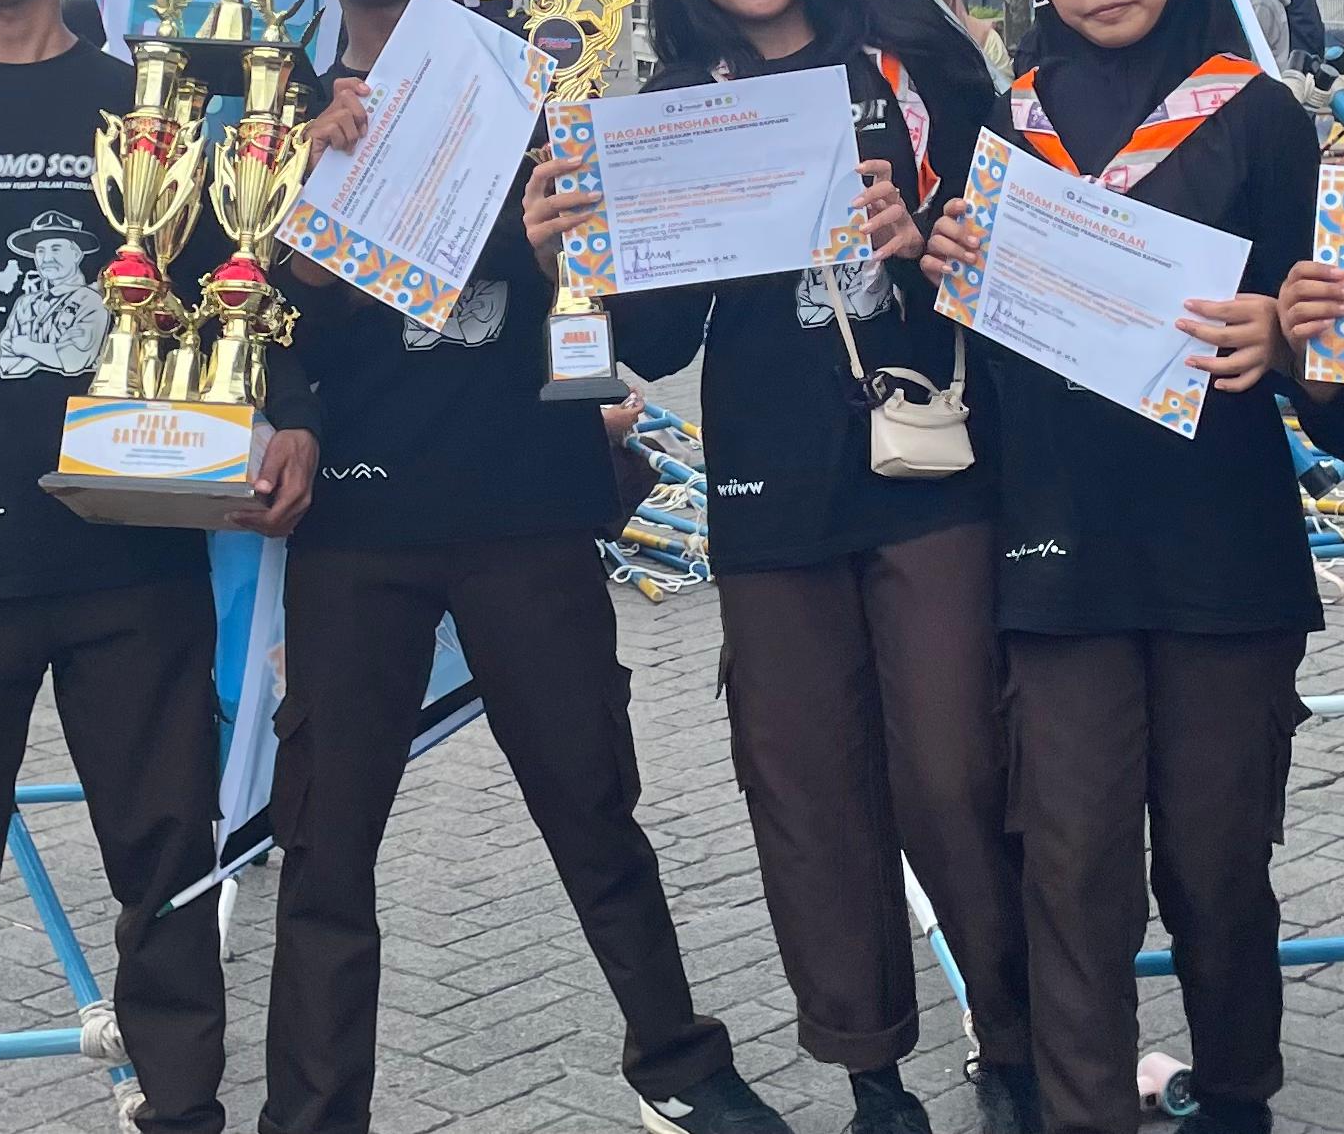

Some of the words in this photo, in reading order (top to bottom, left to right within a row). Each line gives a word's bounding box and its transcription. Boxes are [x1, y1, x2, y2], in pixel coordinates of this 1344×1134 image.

[603, 126, 656, 142] PIAGAM
[658, 110, 758, 134] PENGHARGAAN
[331, 164, 364, 212] PIAGAM
[357, 78, 413, 165] PENGHARGAAN
[46, 152, 97, 178] SCO
[1008, 182, 1054, 211] PIAGAM
[1054, 204, 1146, 250] PENGHARGAAN
[137, 414, 179, 431] PIALA
[163, 431, 205, 448] BAKTI
